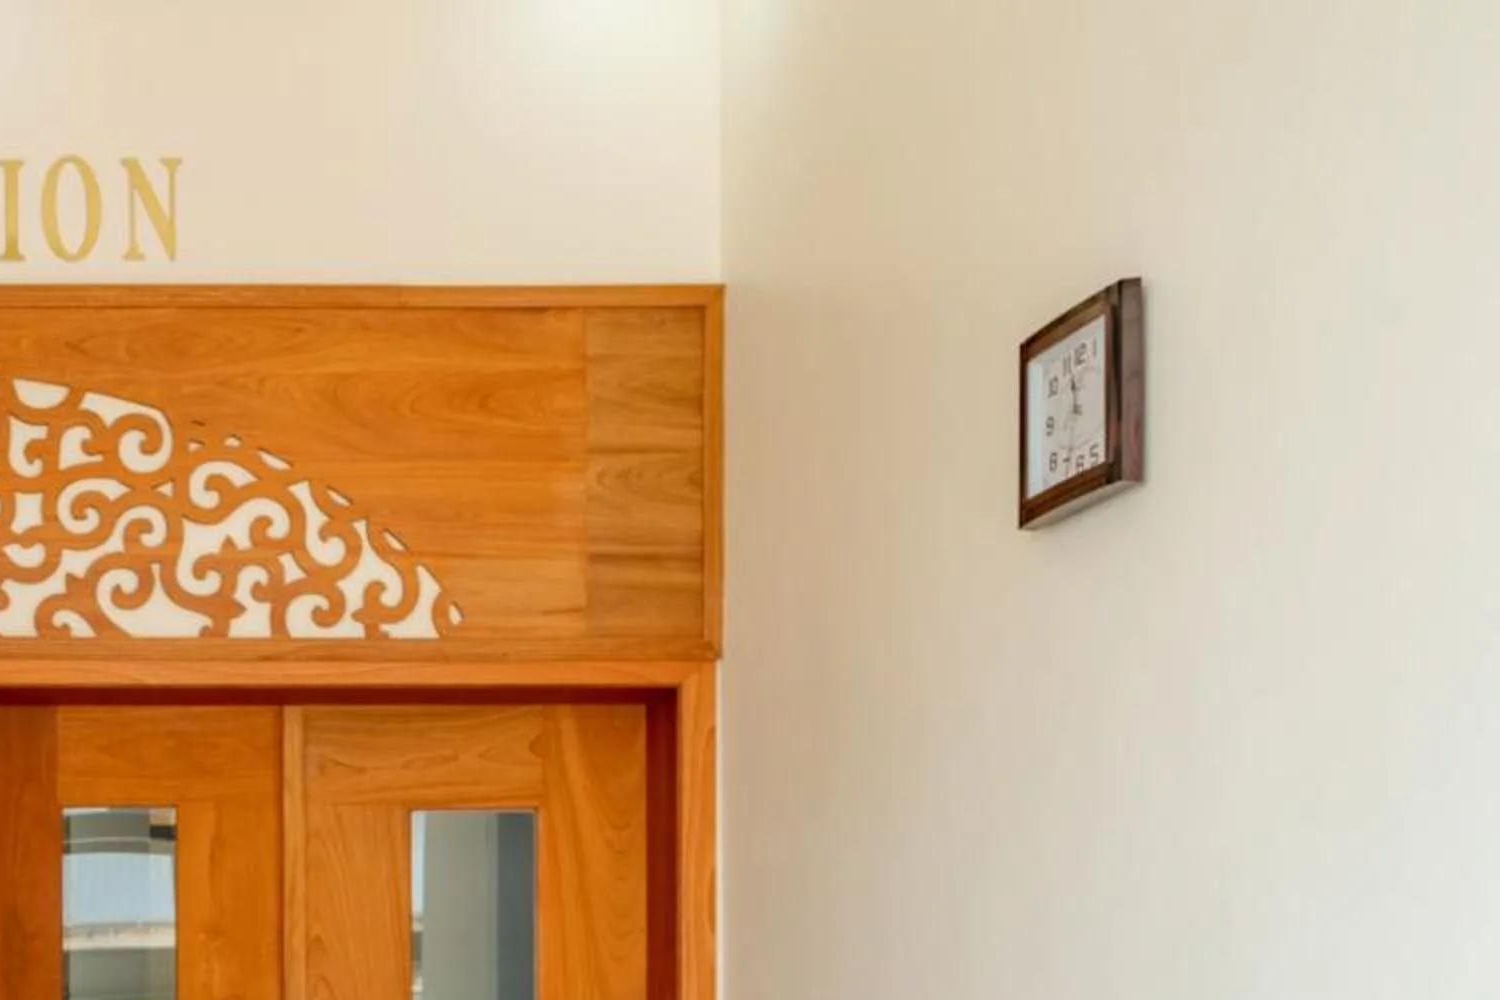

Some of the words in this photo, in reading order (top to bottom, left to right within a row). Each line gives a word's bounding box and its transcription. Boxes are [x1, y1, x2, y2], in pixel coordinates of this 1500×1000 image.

[1062, 352, 1073, 377] 11
[1073, 342, 1088, 367] 12
[1045, 415, 1055, 437] 9
